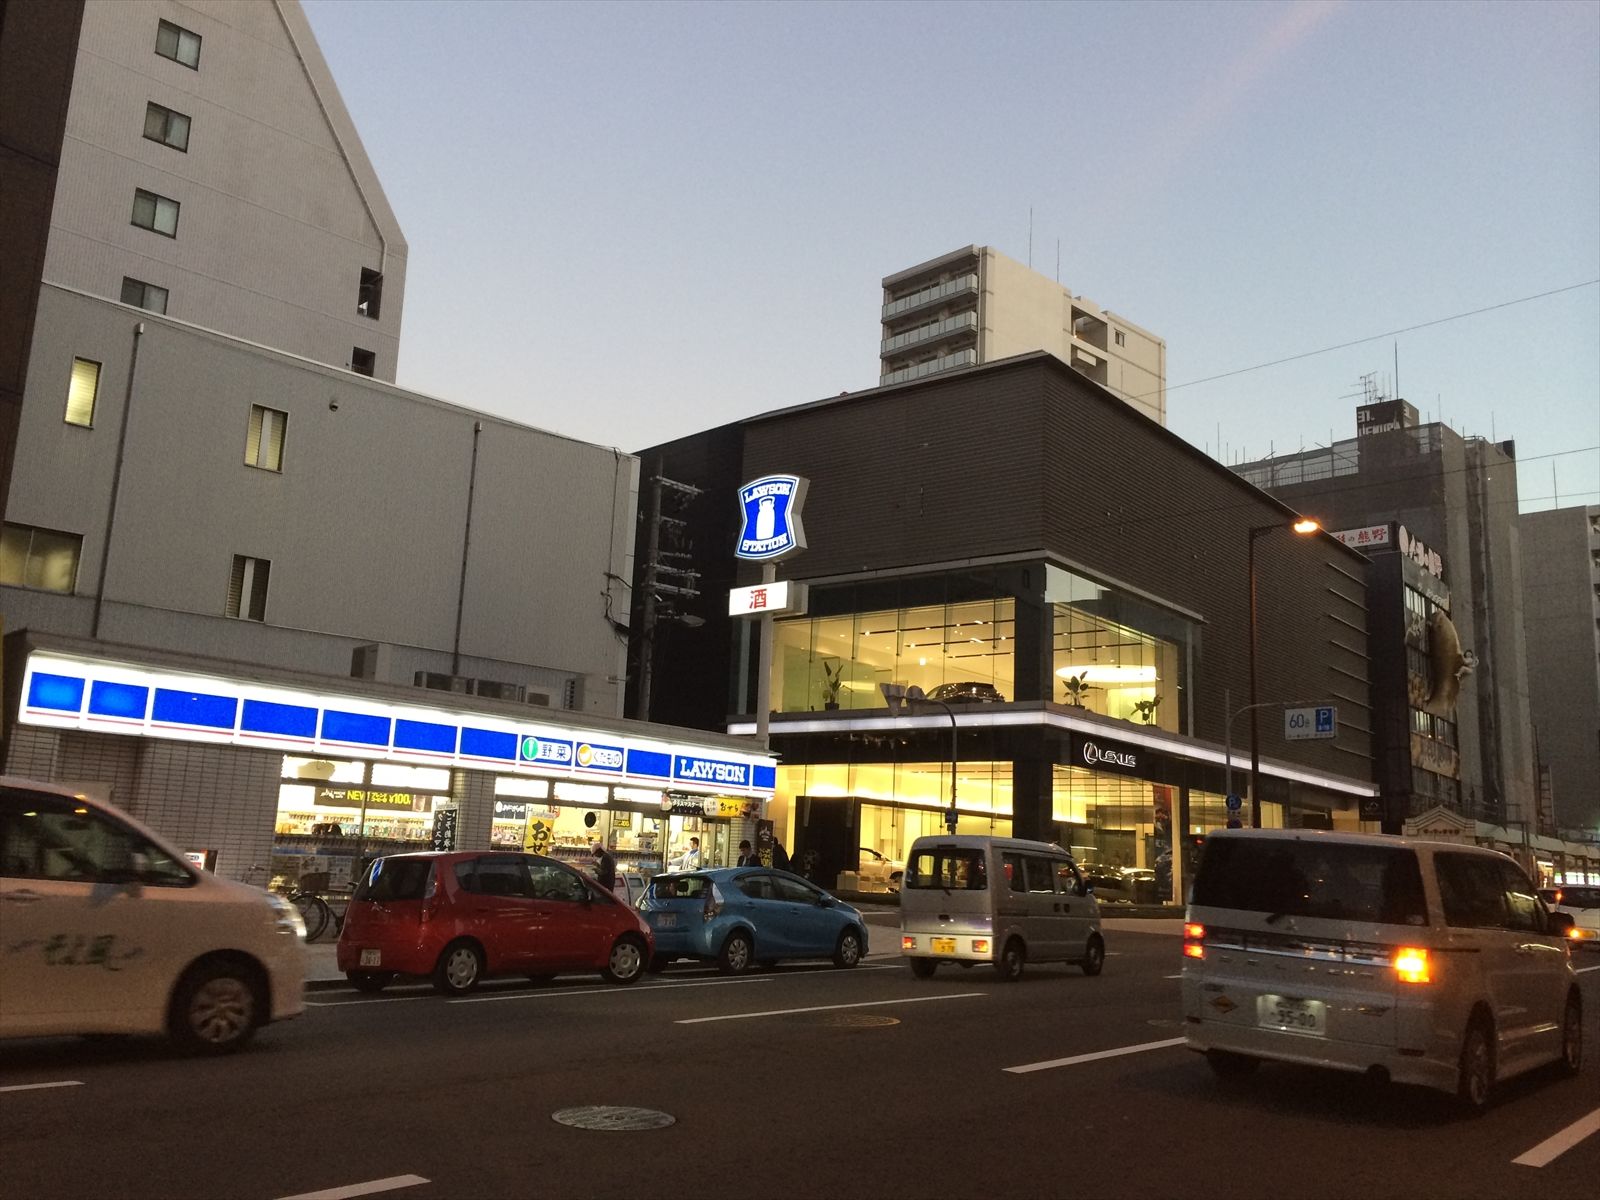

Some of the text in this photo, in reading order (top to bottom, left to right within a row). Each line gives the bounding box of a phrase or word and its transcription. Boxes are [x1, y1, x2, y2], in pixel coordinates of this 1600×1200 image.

[743, 483, 792, 503] LAWSON
[742, 532, 787, 552] STATION
[749, 588, 768, 610] 酒
[1320, 710, 1329, 723] P
[541, 743, 567, 759] 野菜
[1098, 748, 1137, 768] LEXUS
[680, 759, 746, 783] LAWSON
